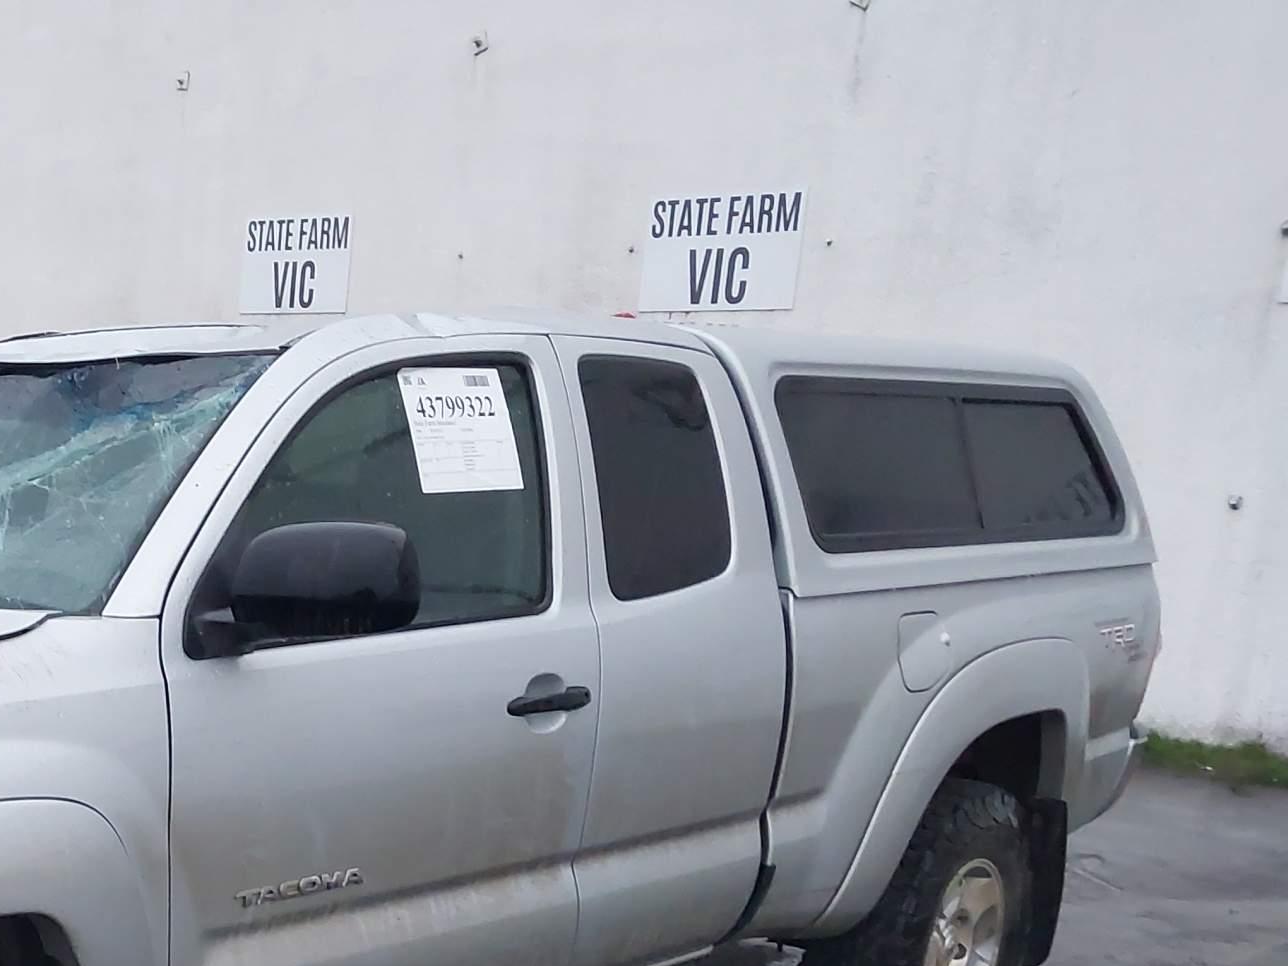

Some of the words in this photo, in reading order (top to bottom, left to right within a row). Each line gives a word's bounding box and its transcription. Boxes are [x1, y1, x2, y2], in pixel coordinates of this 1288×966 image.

[247, 218, 294, 252] STATE
[298, 216, 350, 250] FARM
[652, 197, 721, 238] STATE
[726, 192, 802, 234] FARM
[273, 260, 315, 308] VIC
[689, 246, 750, 304] VIC
[416, 396, 495, 418] 43799322
[234, 867, 362, 907] TACOMA
